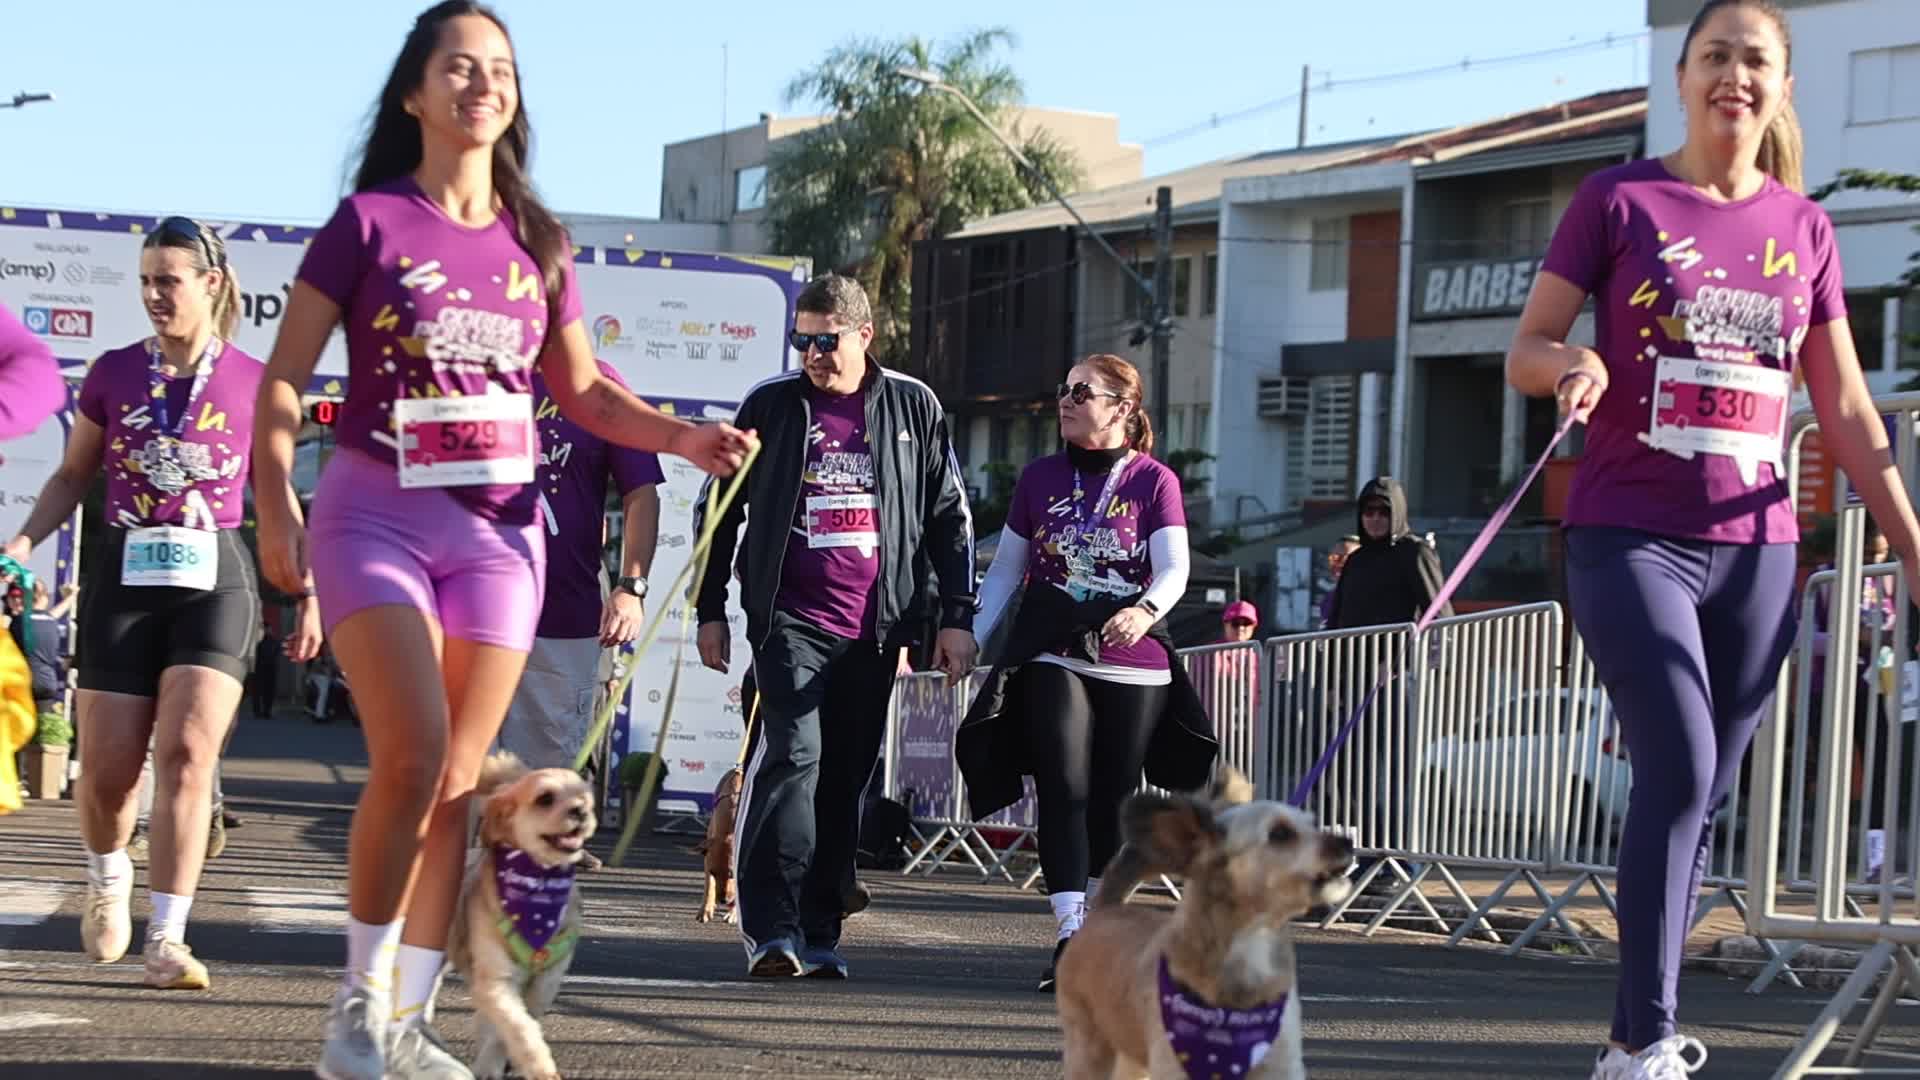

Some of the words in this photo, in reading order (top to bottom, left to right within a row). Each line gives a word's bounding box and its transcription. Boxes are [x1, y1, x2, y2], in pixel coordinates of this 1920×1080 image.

[0, 258, 56, 283] (amp)
[1423, 260, 1543, 313] BARBE
[1697, 385, 1757, 422] 530
[440, 421, 498, 451] 529
[831, 508, 869, 528] 502
[143, 542, 200, 567] 1088
